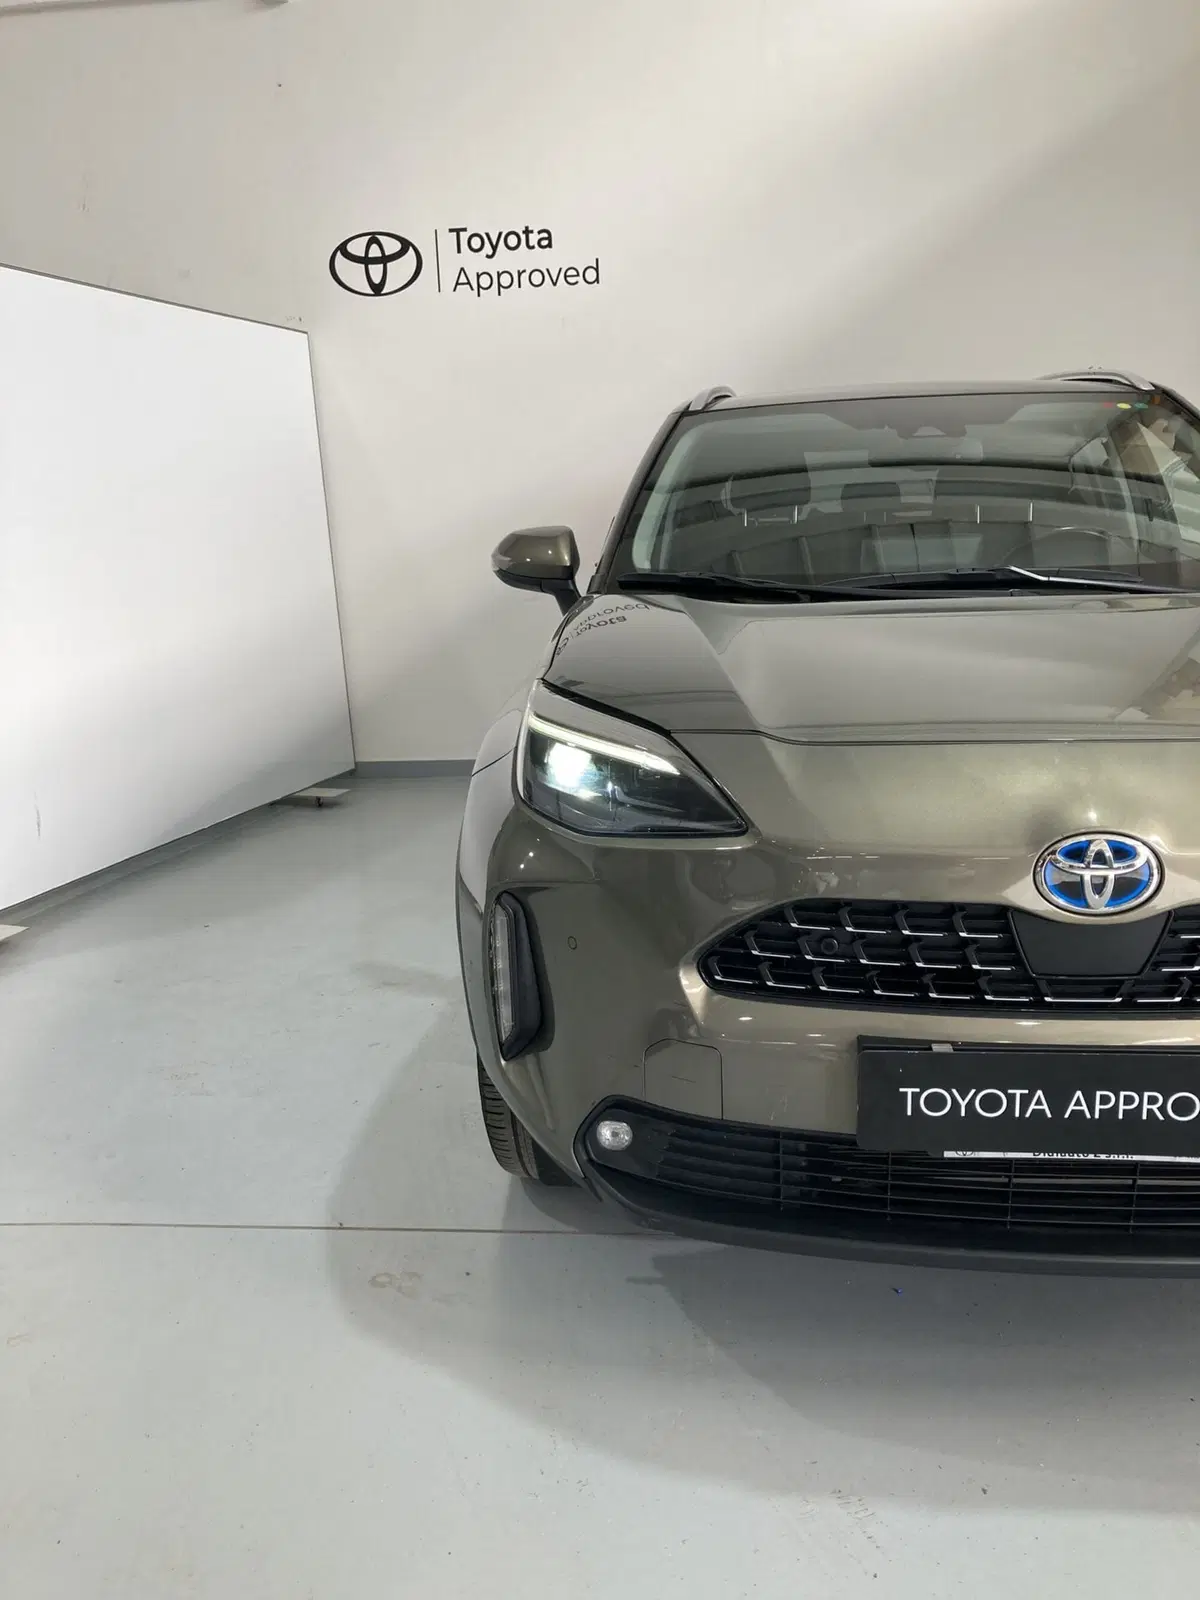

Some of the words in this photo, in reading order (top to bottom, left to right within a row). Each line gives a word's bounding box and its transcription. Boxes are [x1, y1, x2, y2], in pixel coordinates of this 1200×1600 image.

[448, 226, 553, 258] Toyota
[453, 258, 600, 297] Approved
[899, 1087, 1052, 1119] TOYOTA
[1064, 1090, 1200, 1121] APPRO
